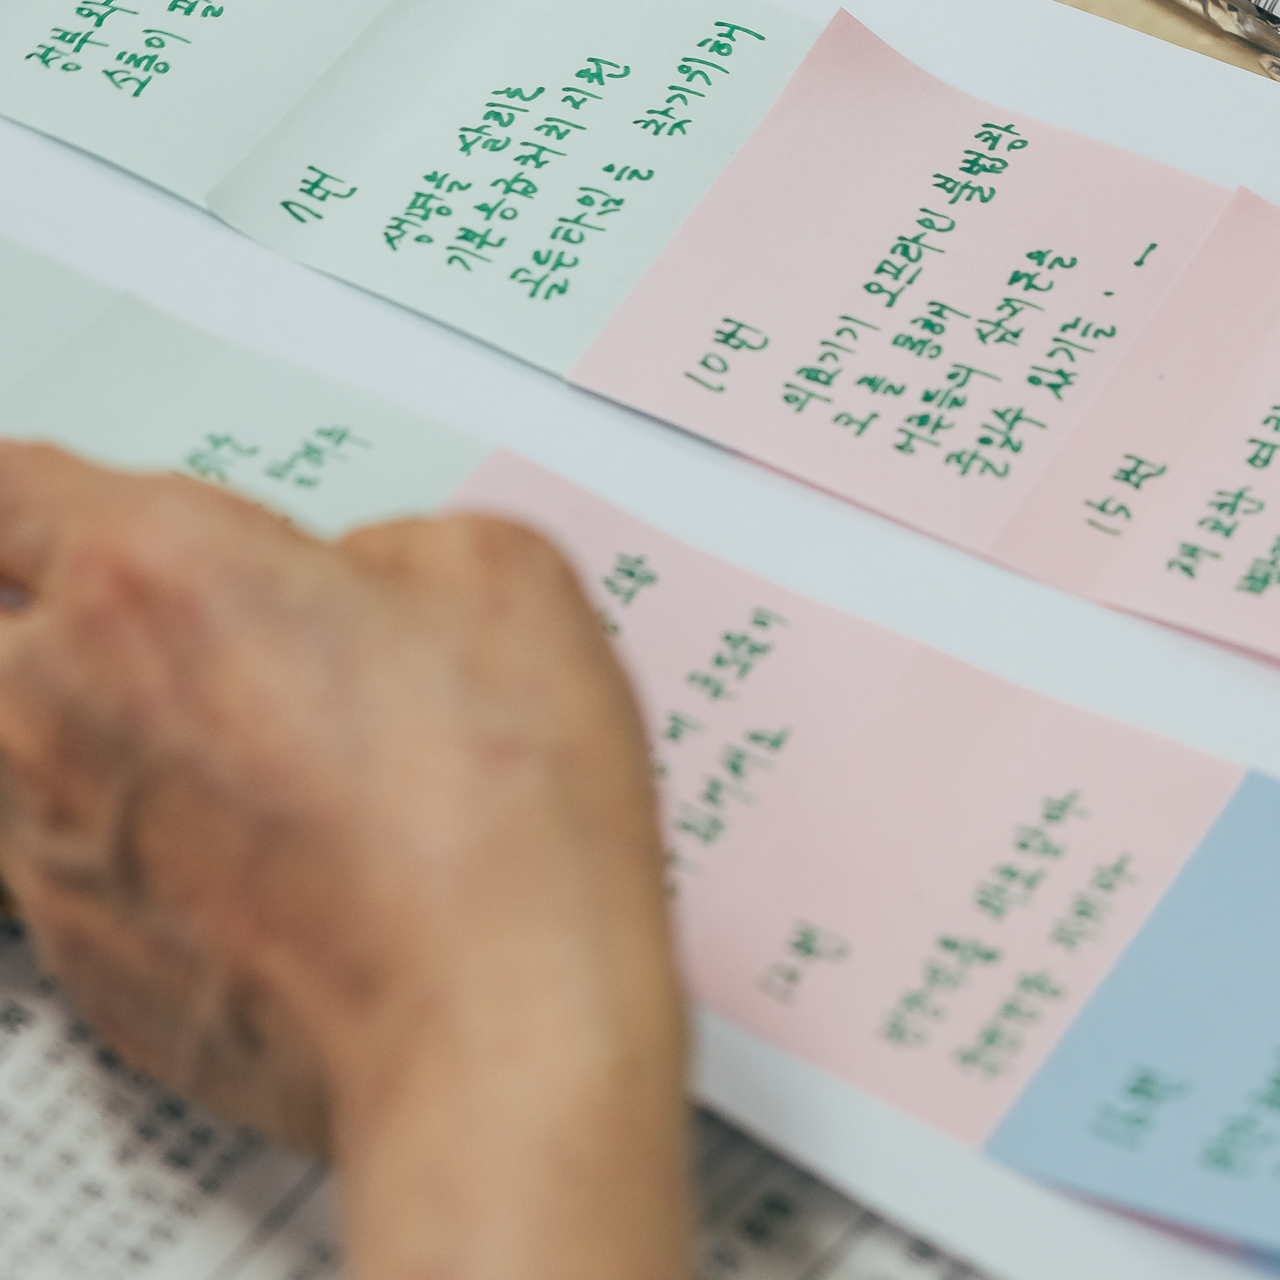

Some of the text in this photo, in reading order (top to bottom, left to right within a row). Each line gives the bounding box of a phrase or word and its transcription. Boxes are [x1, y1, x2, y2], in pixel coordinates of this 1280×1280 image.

[103, 29, 191, 98] 소통이
[384, 86, 545, 250] 생명을 살리는
[782, 315, 880, 414] 의료기기
[863, 207, 956, 308] 오프라인
[891, 300, 972, 360] 통해
